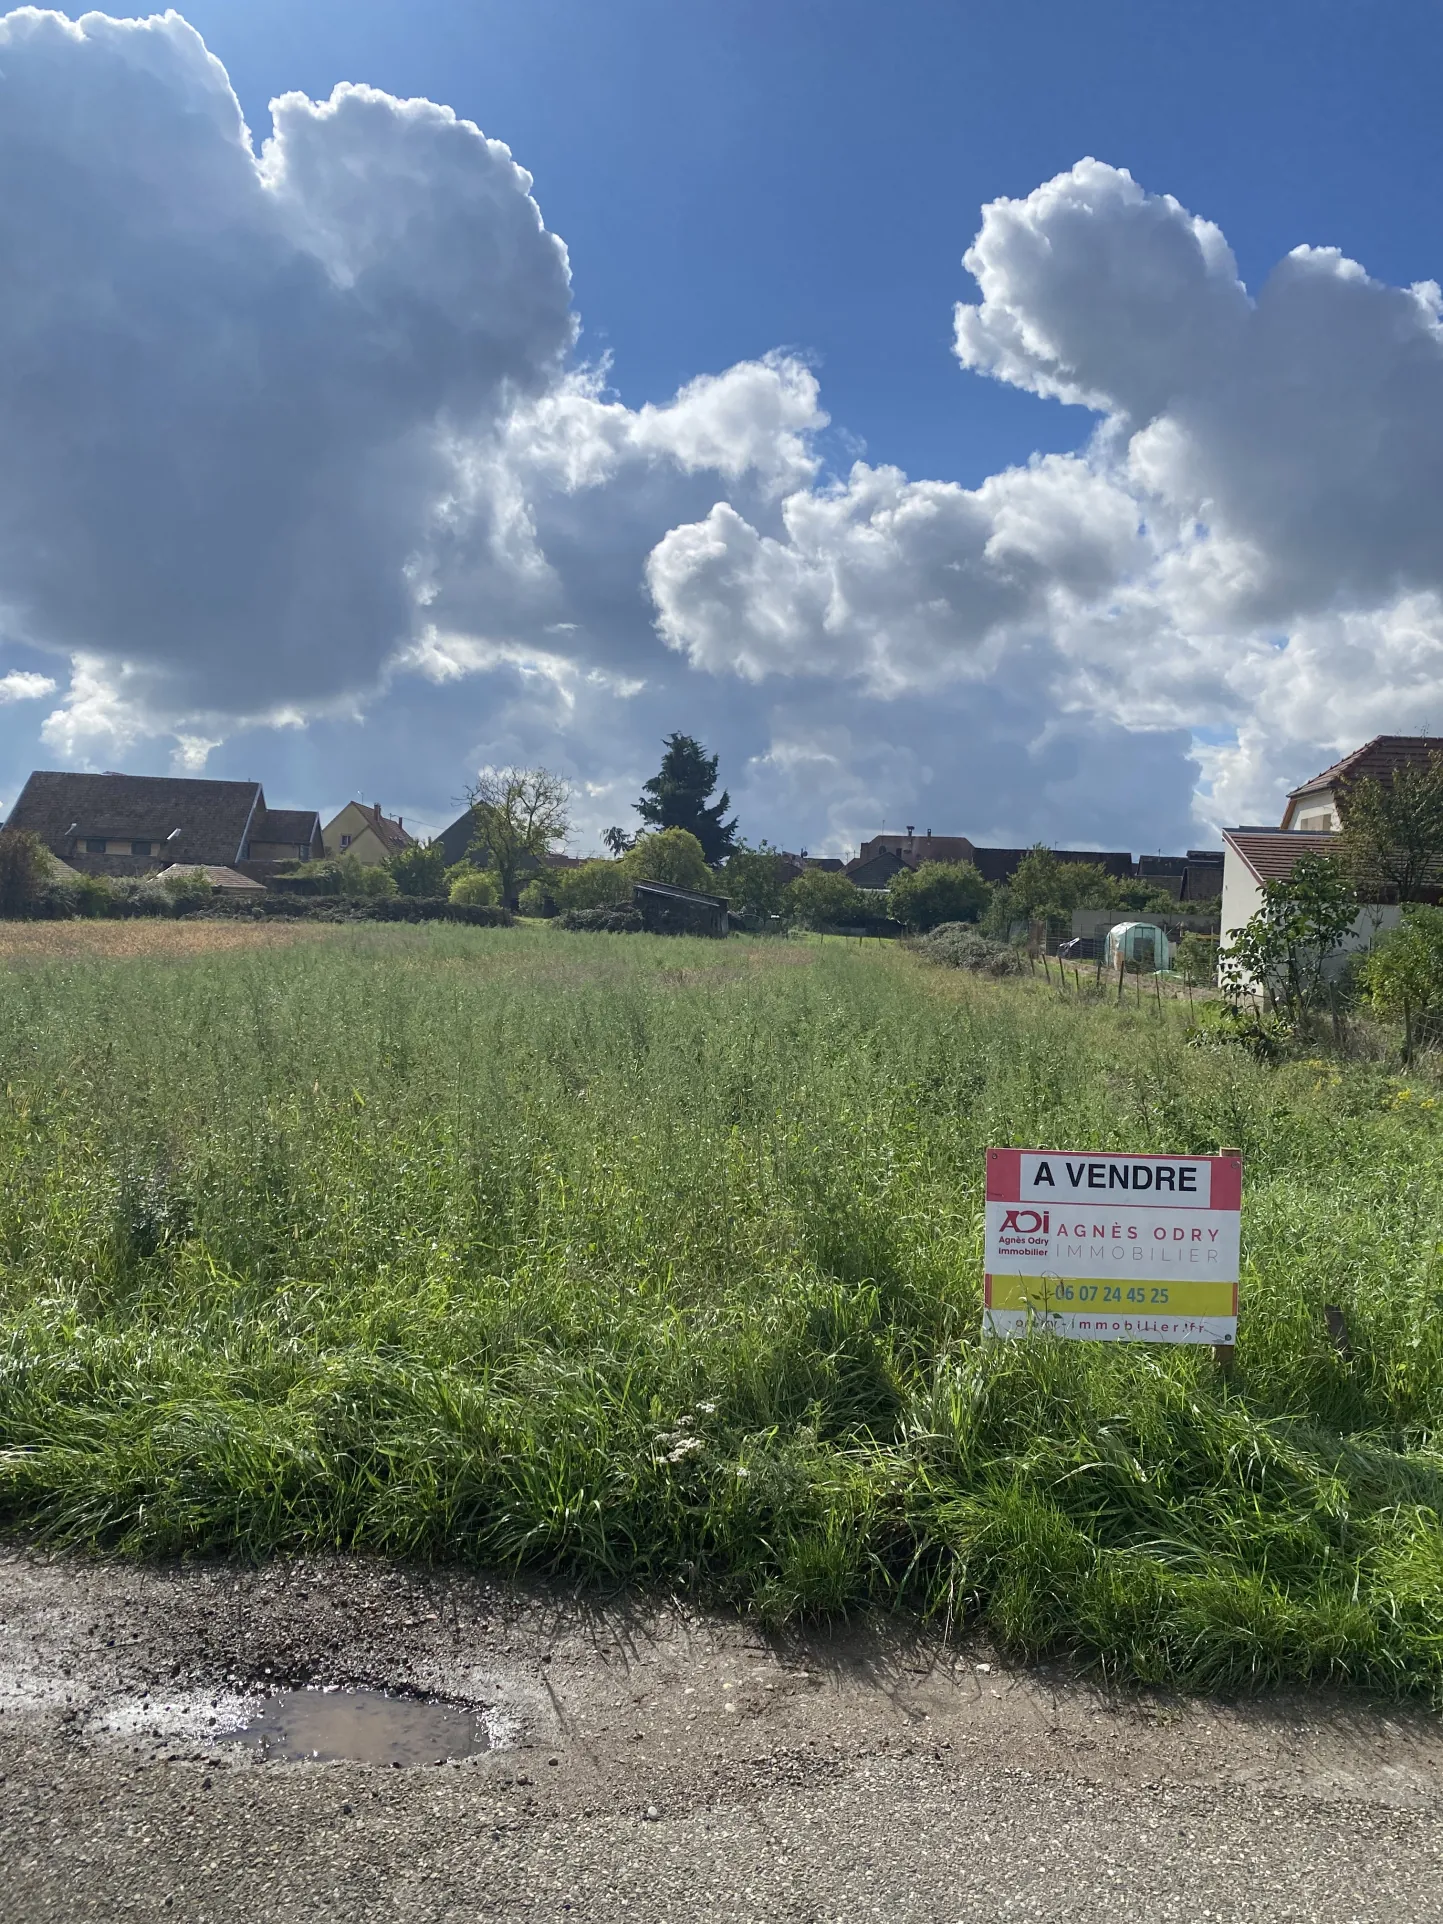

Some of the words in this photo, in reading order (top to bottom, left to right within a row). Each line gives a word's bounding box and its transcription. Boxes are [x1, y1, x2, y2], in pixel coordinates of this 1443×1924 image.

[1033, 1161, 1056, 1187] A
[1065, 1162, 1198, 1192] VENDRE
[998, 1235, 1026, 1246] Agnès
[1027, 1236, 1049, 1247] Odry
[1056, 1222, 1139, 1240] AGNÈS
[1153, 1226, 1220, 1243] ODRY
[998, 1247, 1048, 1256] Immobilier
[1056, 1243, 1219, 1264] IMMOBILIER
[1055, 1284, 1074, 1301] 06
[1079, 1285, 1098, 1301] 07
[1103, 1286, 1122, 1302] 24
[1126, 1287, 1145, 1303] 45
[1150, 1288, 1169, 1304] 25
